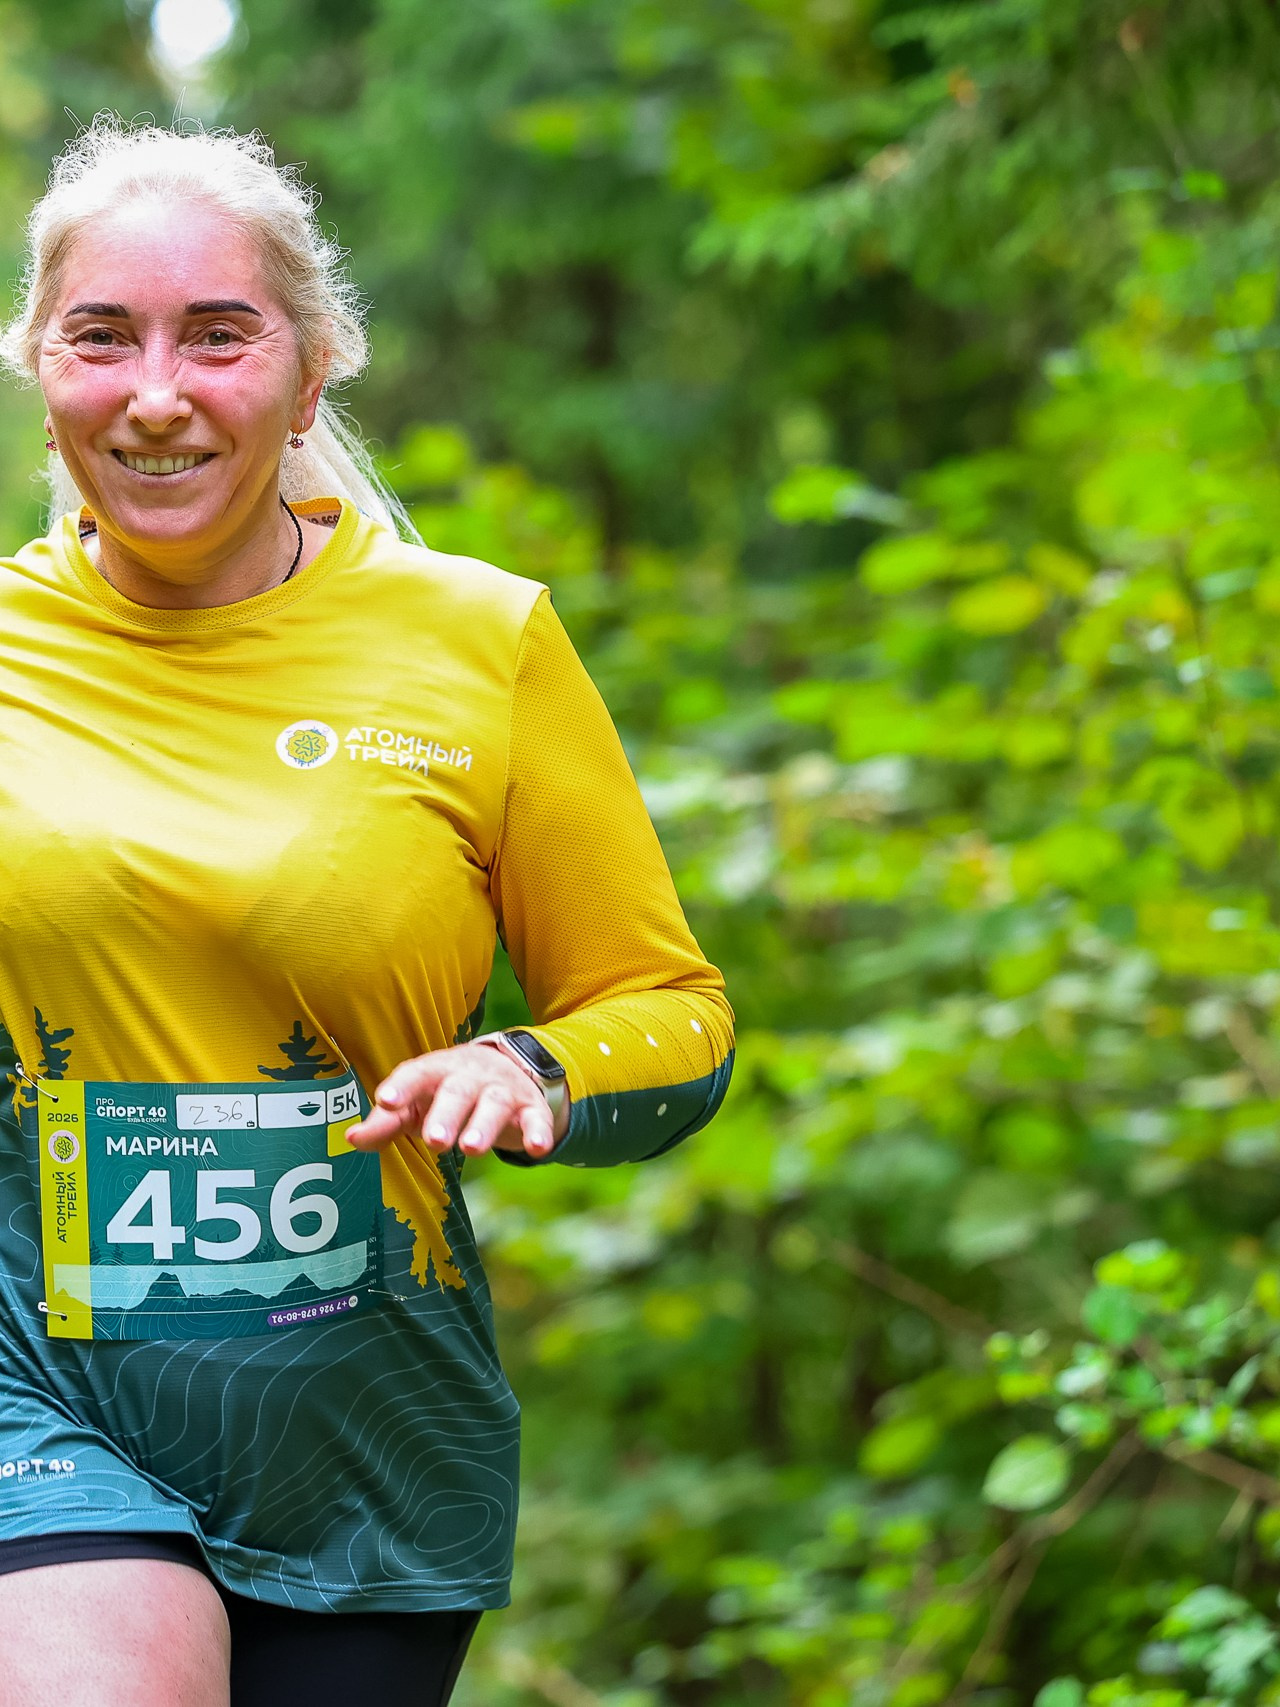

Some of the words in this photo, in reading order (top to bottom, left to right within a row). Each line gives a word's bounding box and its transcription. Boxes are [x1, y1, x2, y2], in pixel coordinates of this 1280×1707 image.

[344, 726, 473, 772] АТОМНЫЙ
[344, 744, 430, 777] ТРЕЙЛ
[95, 1097, 115, 1106] ПРО
[47, 1112, 79, 1123] 2026
[96, 1106, 146, 1118] СПОРТ
[147, 1106, 167, 1118] 40
[106, 1136, 219, 1156] МАРИНА
[52, 1171, 67, 1243] АТОМНЫЙ
[106, 1162, 340, 1261] 456
[271, 1308, 317, 1324] 878-80-91
[319, 1303, 335, 1315] 926
[48, 1458, 76, 1473] 40
